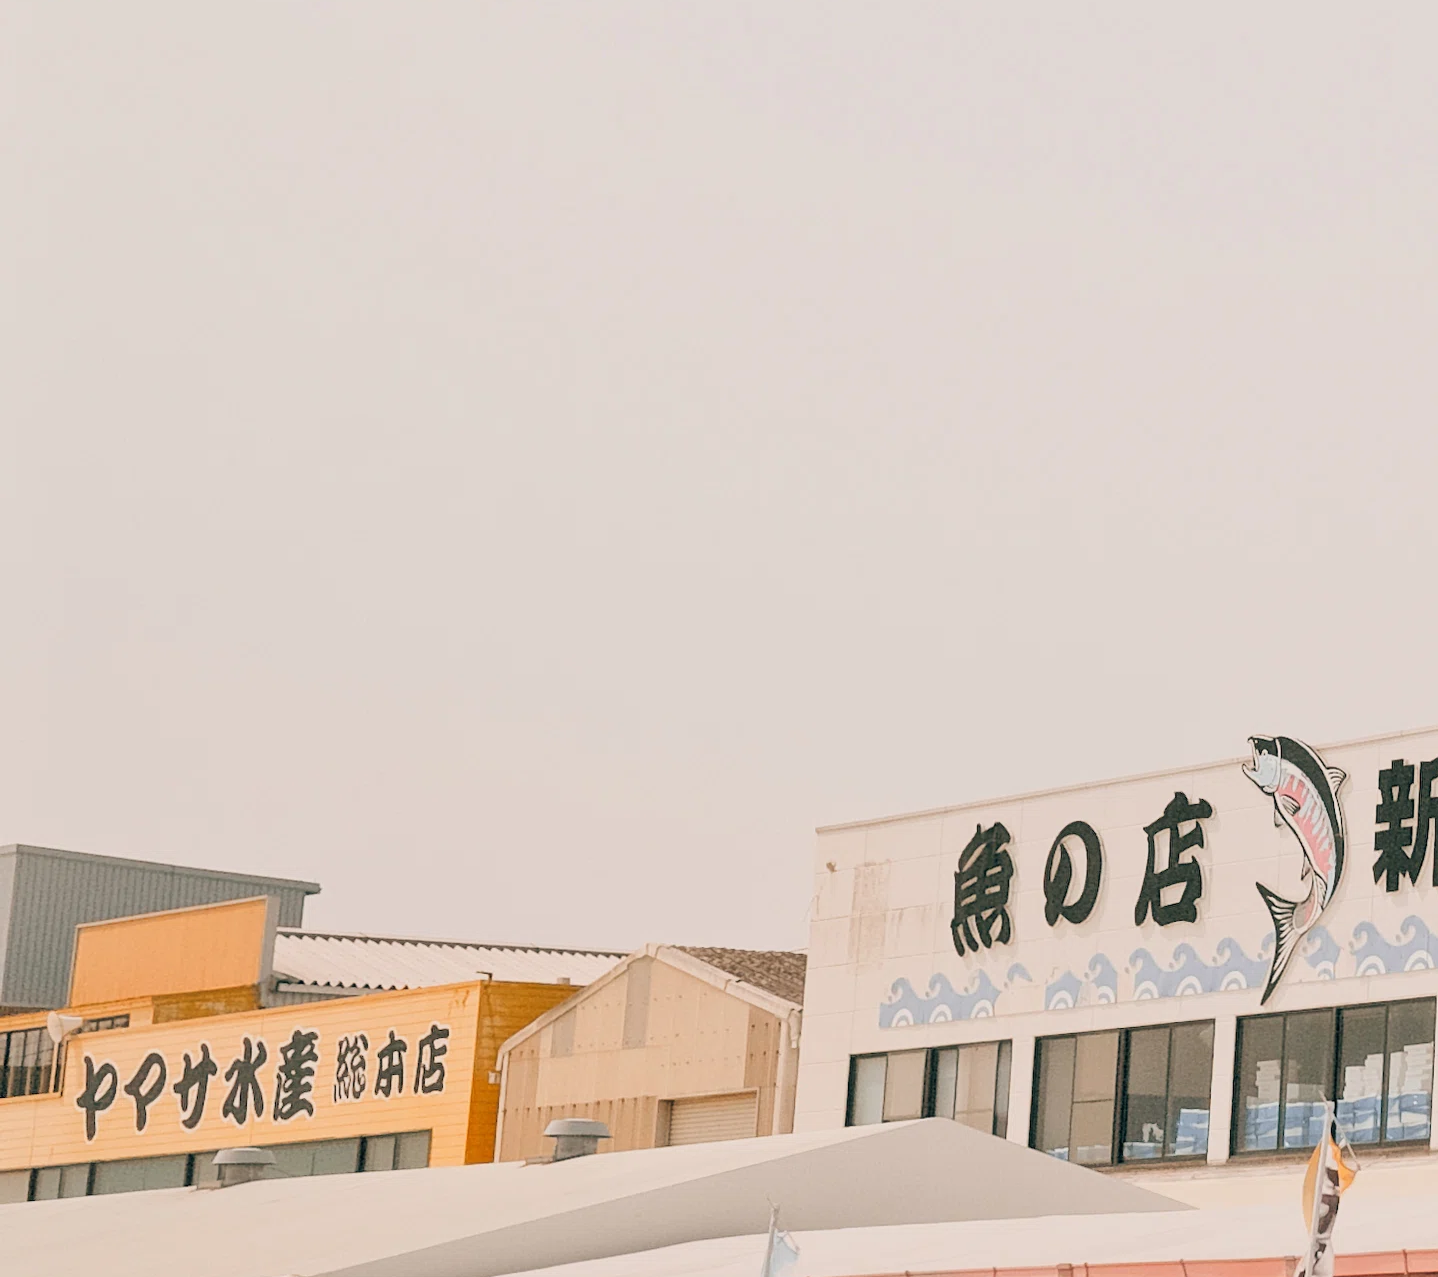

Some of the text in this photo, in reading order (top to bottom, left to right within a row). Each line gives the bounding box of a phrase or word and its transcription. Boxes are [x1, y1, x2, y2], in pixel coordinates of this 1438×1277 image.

[949, 790, 1215, 956] 魚の店
[75, 1023, 451, 1142] ヤマサ水産 総本店
